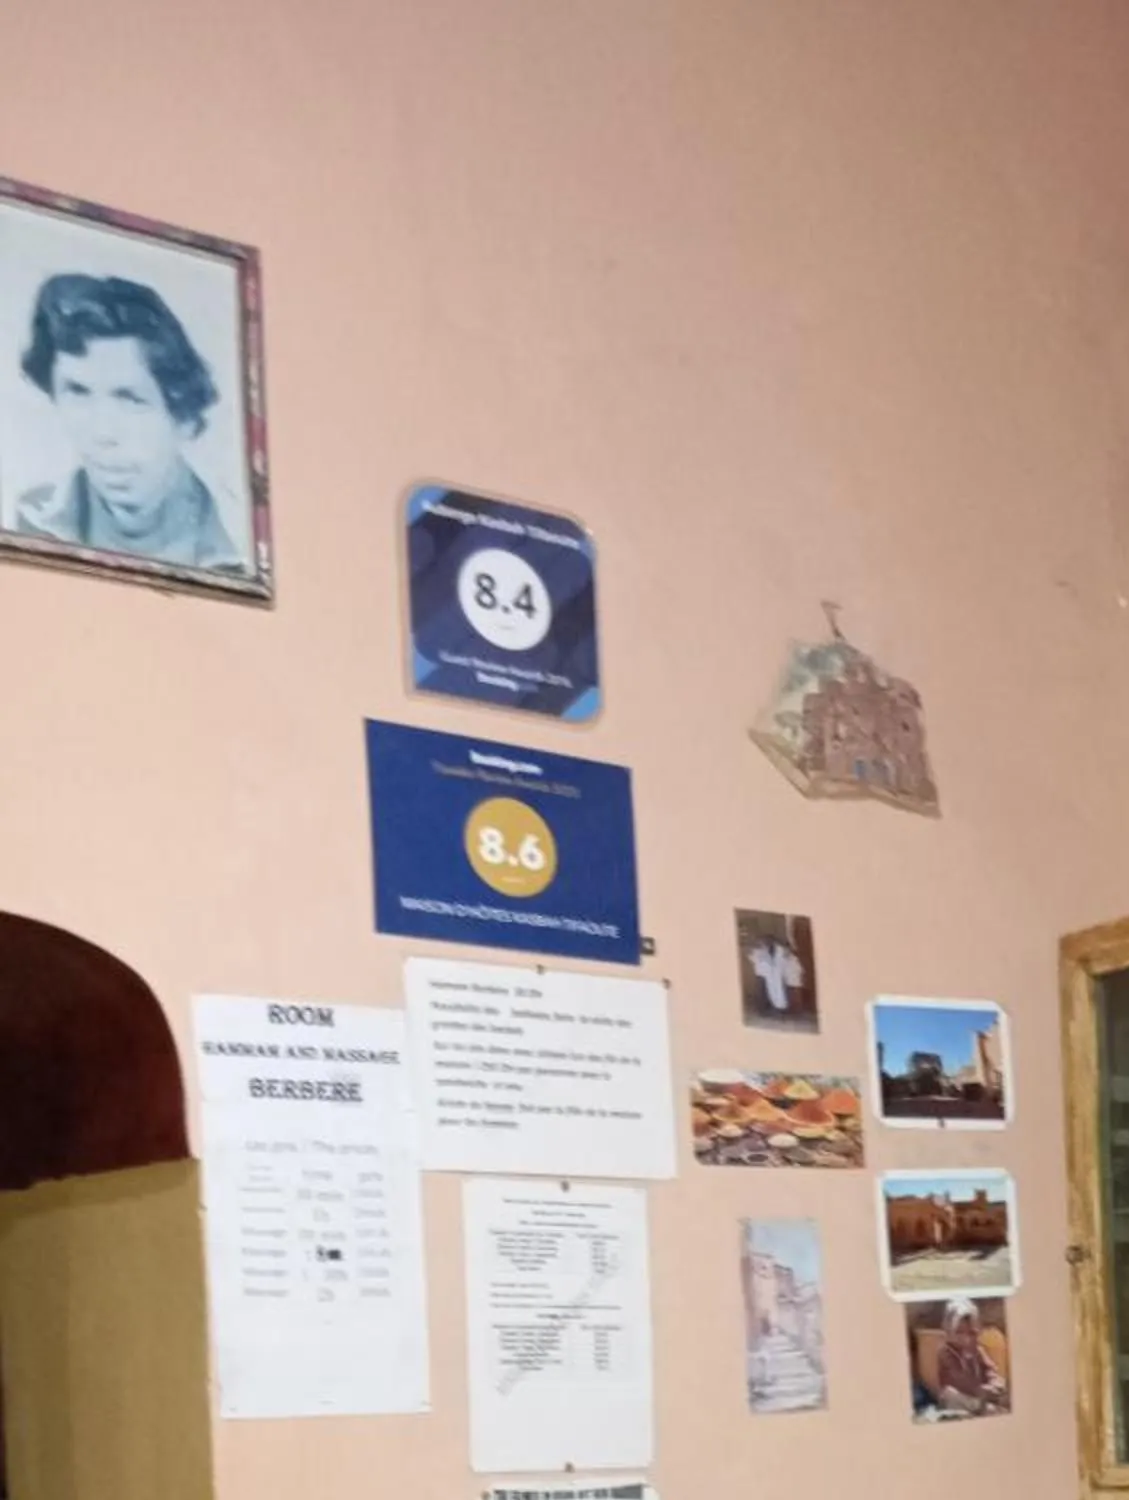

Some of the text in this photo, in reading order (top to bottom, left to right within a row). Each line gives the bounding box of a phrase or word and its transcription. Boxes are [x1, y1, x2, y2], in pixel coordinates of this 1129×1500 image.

[474, 571, 537, 620] 8.4
[478, 825, 547, 872] 8.6
[267, 1003, 335, 1028] ROOM
